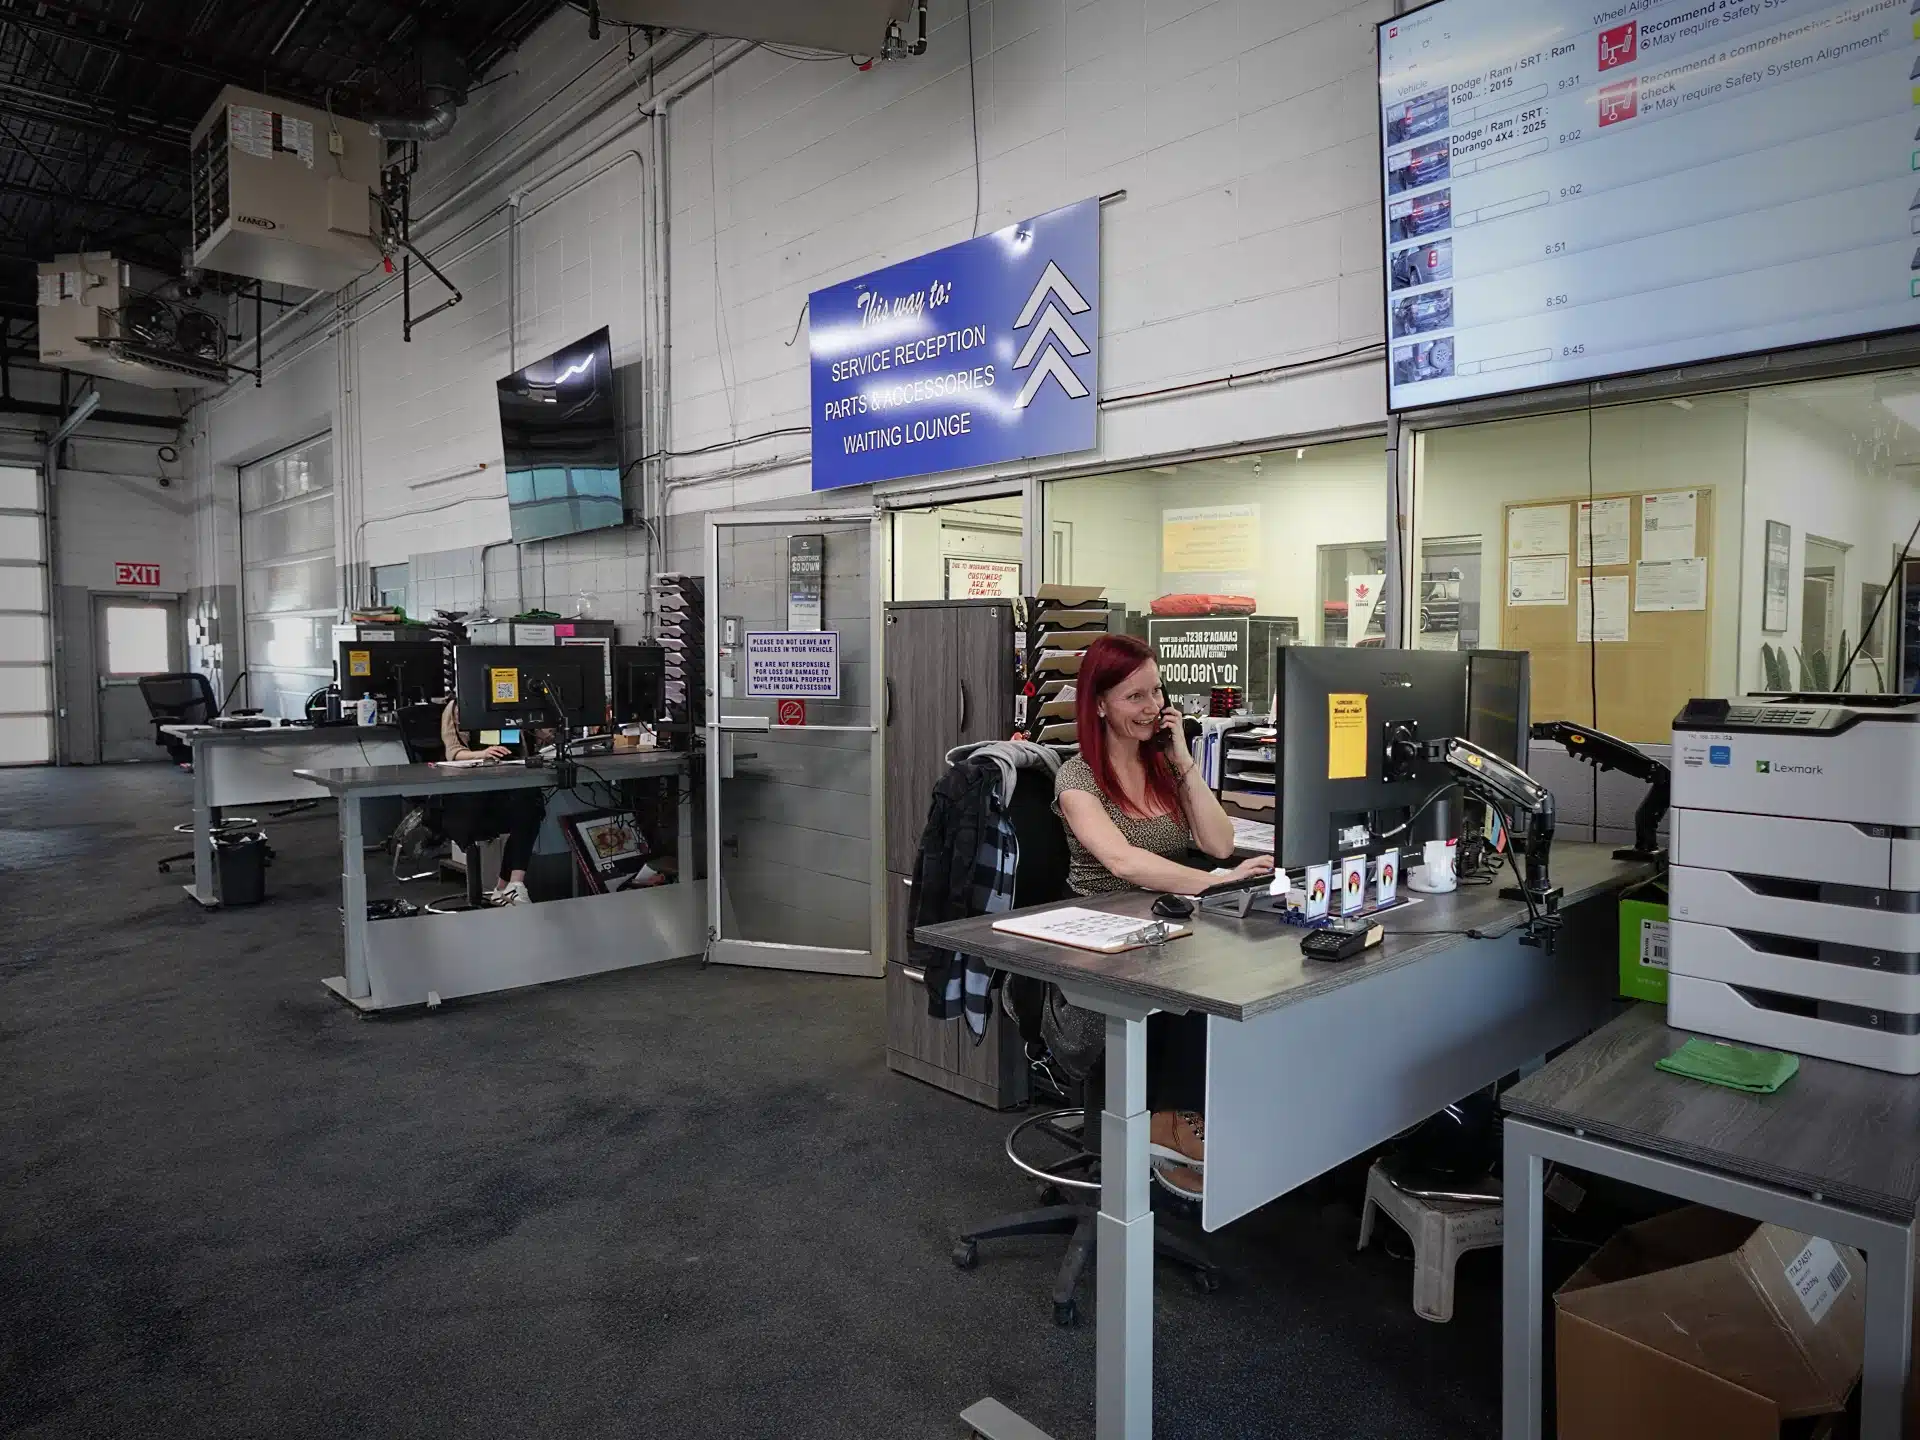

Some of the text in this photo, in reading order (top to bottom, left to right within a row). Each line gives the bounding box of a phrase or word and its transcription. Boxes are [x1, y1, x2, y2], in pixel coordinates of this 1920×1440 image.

[1593, 8, 1626, 25] Wheel
[1641, 0, 1727, 36] Recommend a
[1653, 31, 1676, 47] May
[1680, 17, 1720, 38] require
[1723, 3, 1762, 23] Safety
[1641, 53, 1716, 85] Recommend
[1719, 53, 1727, 62] a
[1730, 18, 1831, 58] comprehensive
[1451, 77, 1482, 95] Dodge
[1489, 65, 1512, 80] Ram
[1520, 54, 1542, 70] SRT
[1551, 43, 1576, 59] Ram
[1398, 79, 1428, 96] Vehicle
[1489, 77, 1513, 93] 2015
[1558, 75, 1581, 90] 9:31
[1640, 81, 1677, 101] check
[1655, 96, 1680, 112] May
[1682, 81, 1723, 104] require
[1725, 68, 1763, 88] Safety
[1767, 54, 1814, 78] System
[1452, 128, 1483, 146] Dodge
[1490, 118, 1513, 133] Ram
[1521, 107, 1543, 122] SRT
[1452, 138, 1493, 157] Durango
[1495, 129, 1514, 144] 4X4
[1522, 120, 1547, 136] 2025
[1559, 129, 1581, 145] 9:02
[1560, 183, 1582, 198] 9:02
[1545, 241, 1567, 256] 8:51
[857, 279, 951, 328] This way to:
[1546, 294, 1568, 308] 8:50
[831, 324, 986, 382] SERVICE RECEPTION
[1562, 343, 1585, 357] 8:45
[825, 365, 995, 422] PARTS & ACCESSORIES
[843, 412, 971, 455] WAITING LOUNGE
[116, 565, 160, 585] EXIT
[968, 572, 1002, 581] CUSTOMERS
[968, 588, 1002, 596] PERMITTED
[1774, 762, 1824, 776] Lexmark
[1874, 896, 1880, 906] 1
[1872, 956, 1881, 966] 2
[1870, 1014, 1878, 1024] 3
